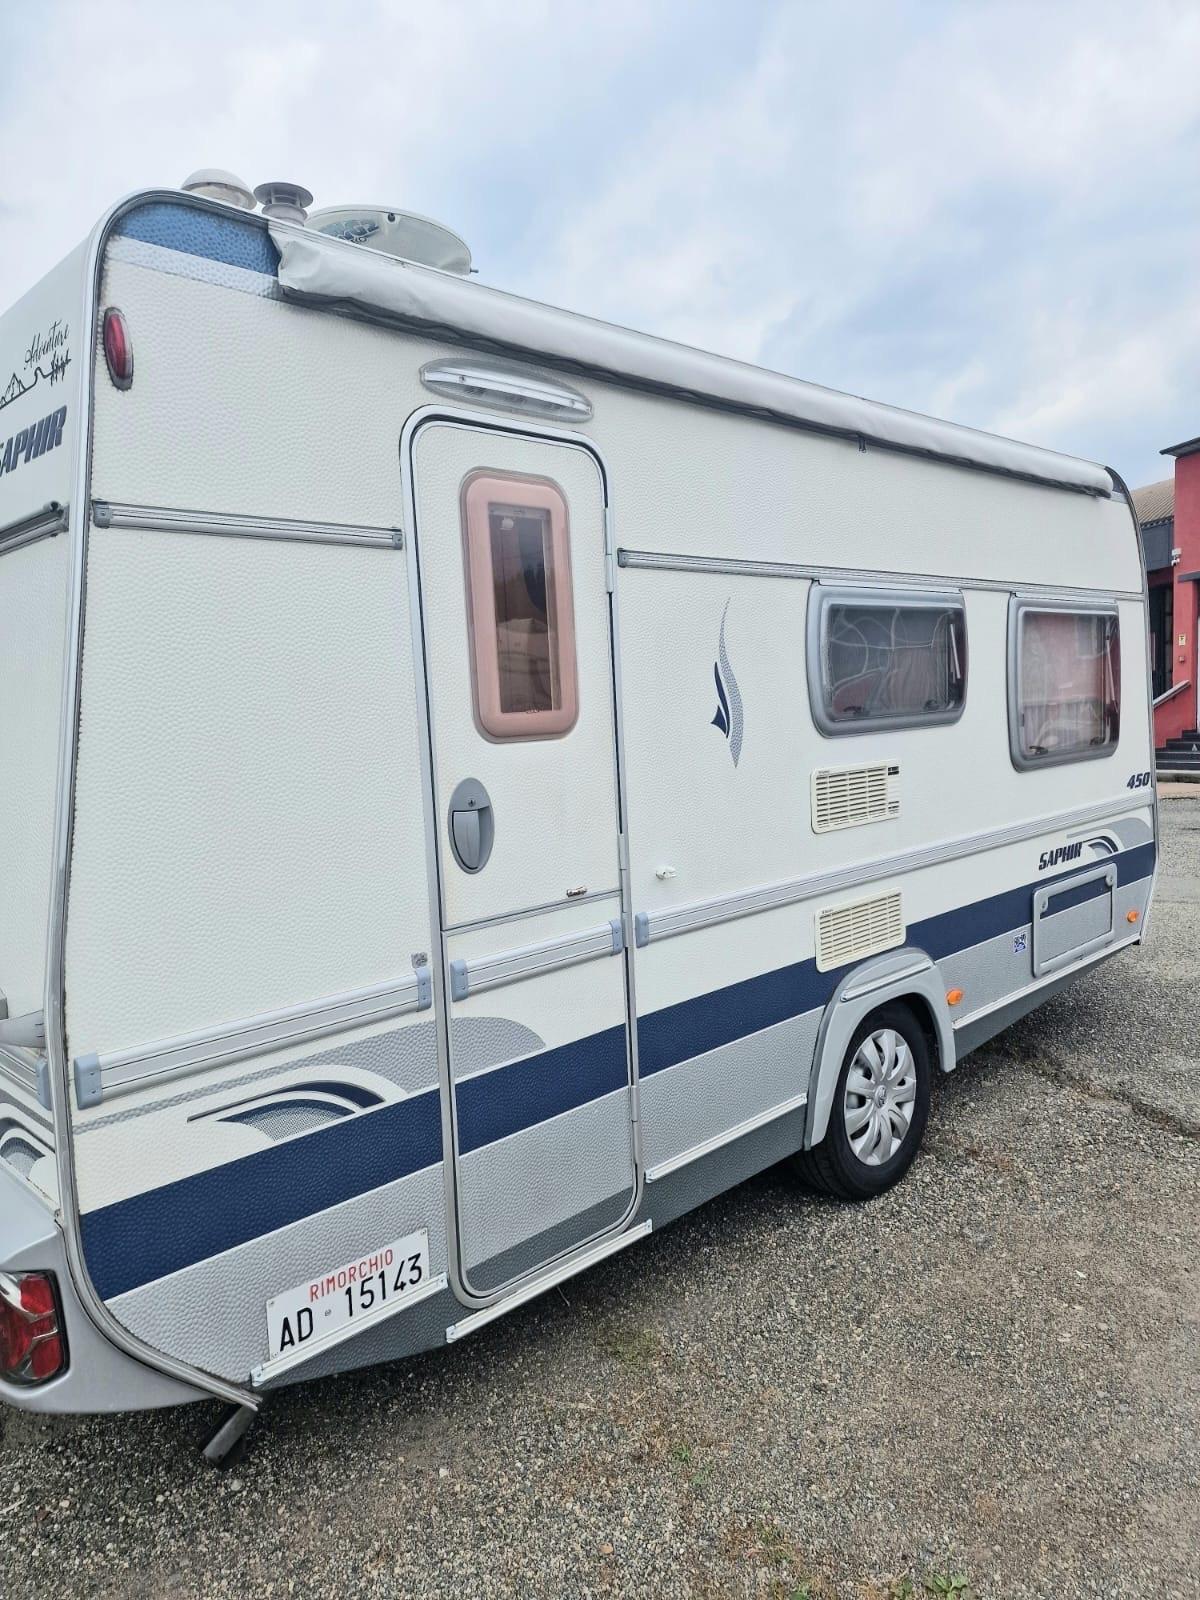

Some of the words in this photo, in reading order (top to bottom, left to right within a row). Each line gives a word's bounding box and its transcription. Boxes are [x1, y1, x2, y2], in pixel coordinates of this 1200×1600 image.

[24, 319, 69, 370] Adventure
[1126, 771, 1151, 790] 450
[1038, 841, 1083, 871] SAPHIR
[309, 1248, 394, 1303] RIMORCHIO
[279, 1306, 314, 1352] AD
[344, 1252, 423, 1317] 15143
